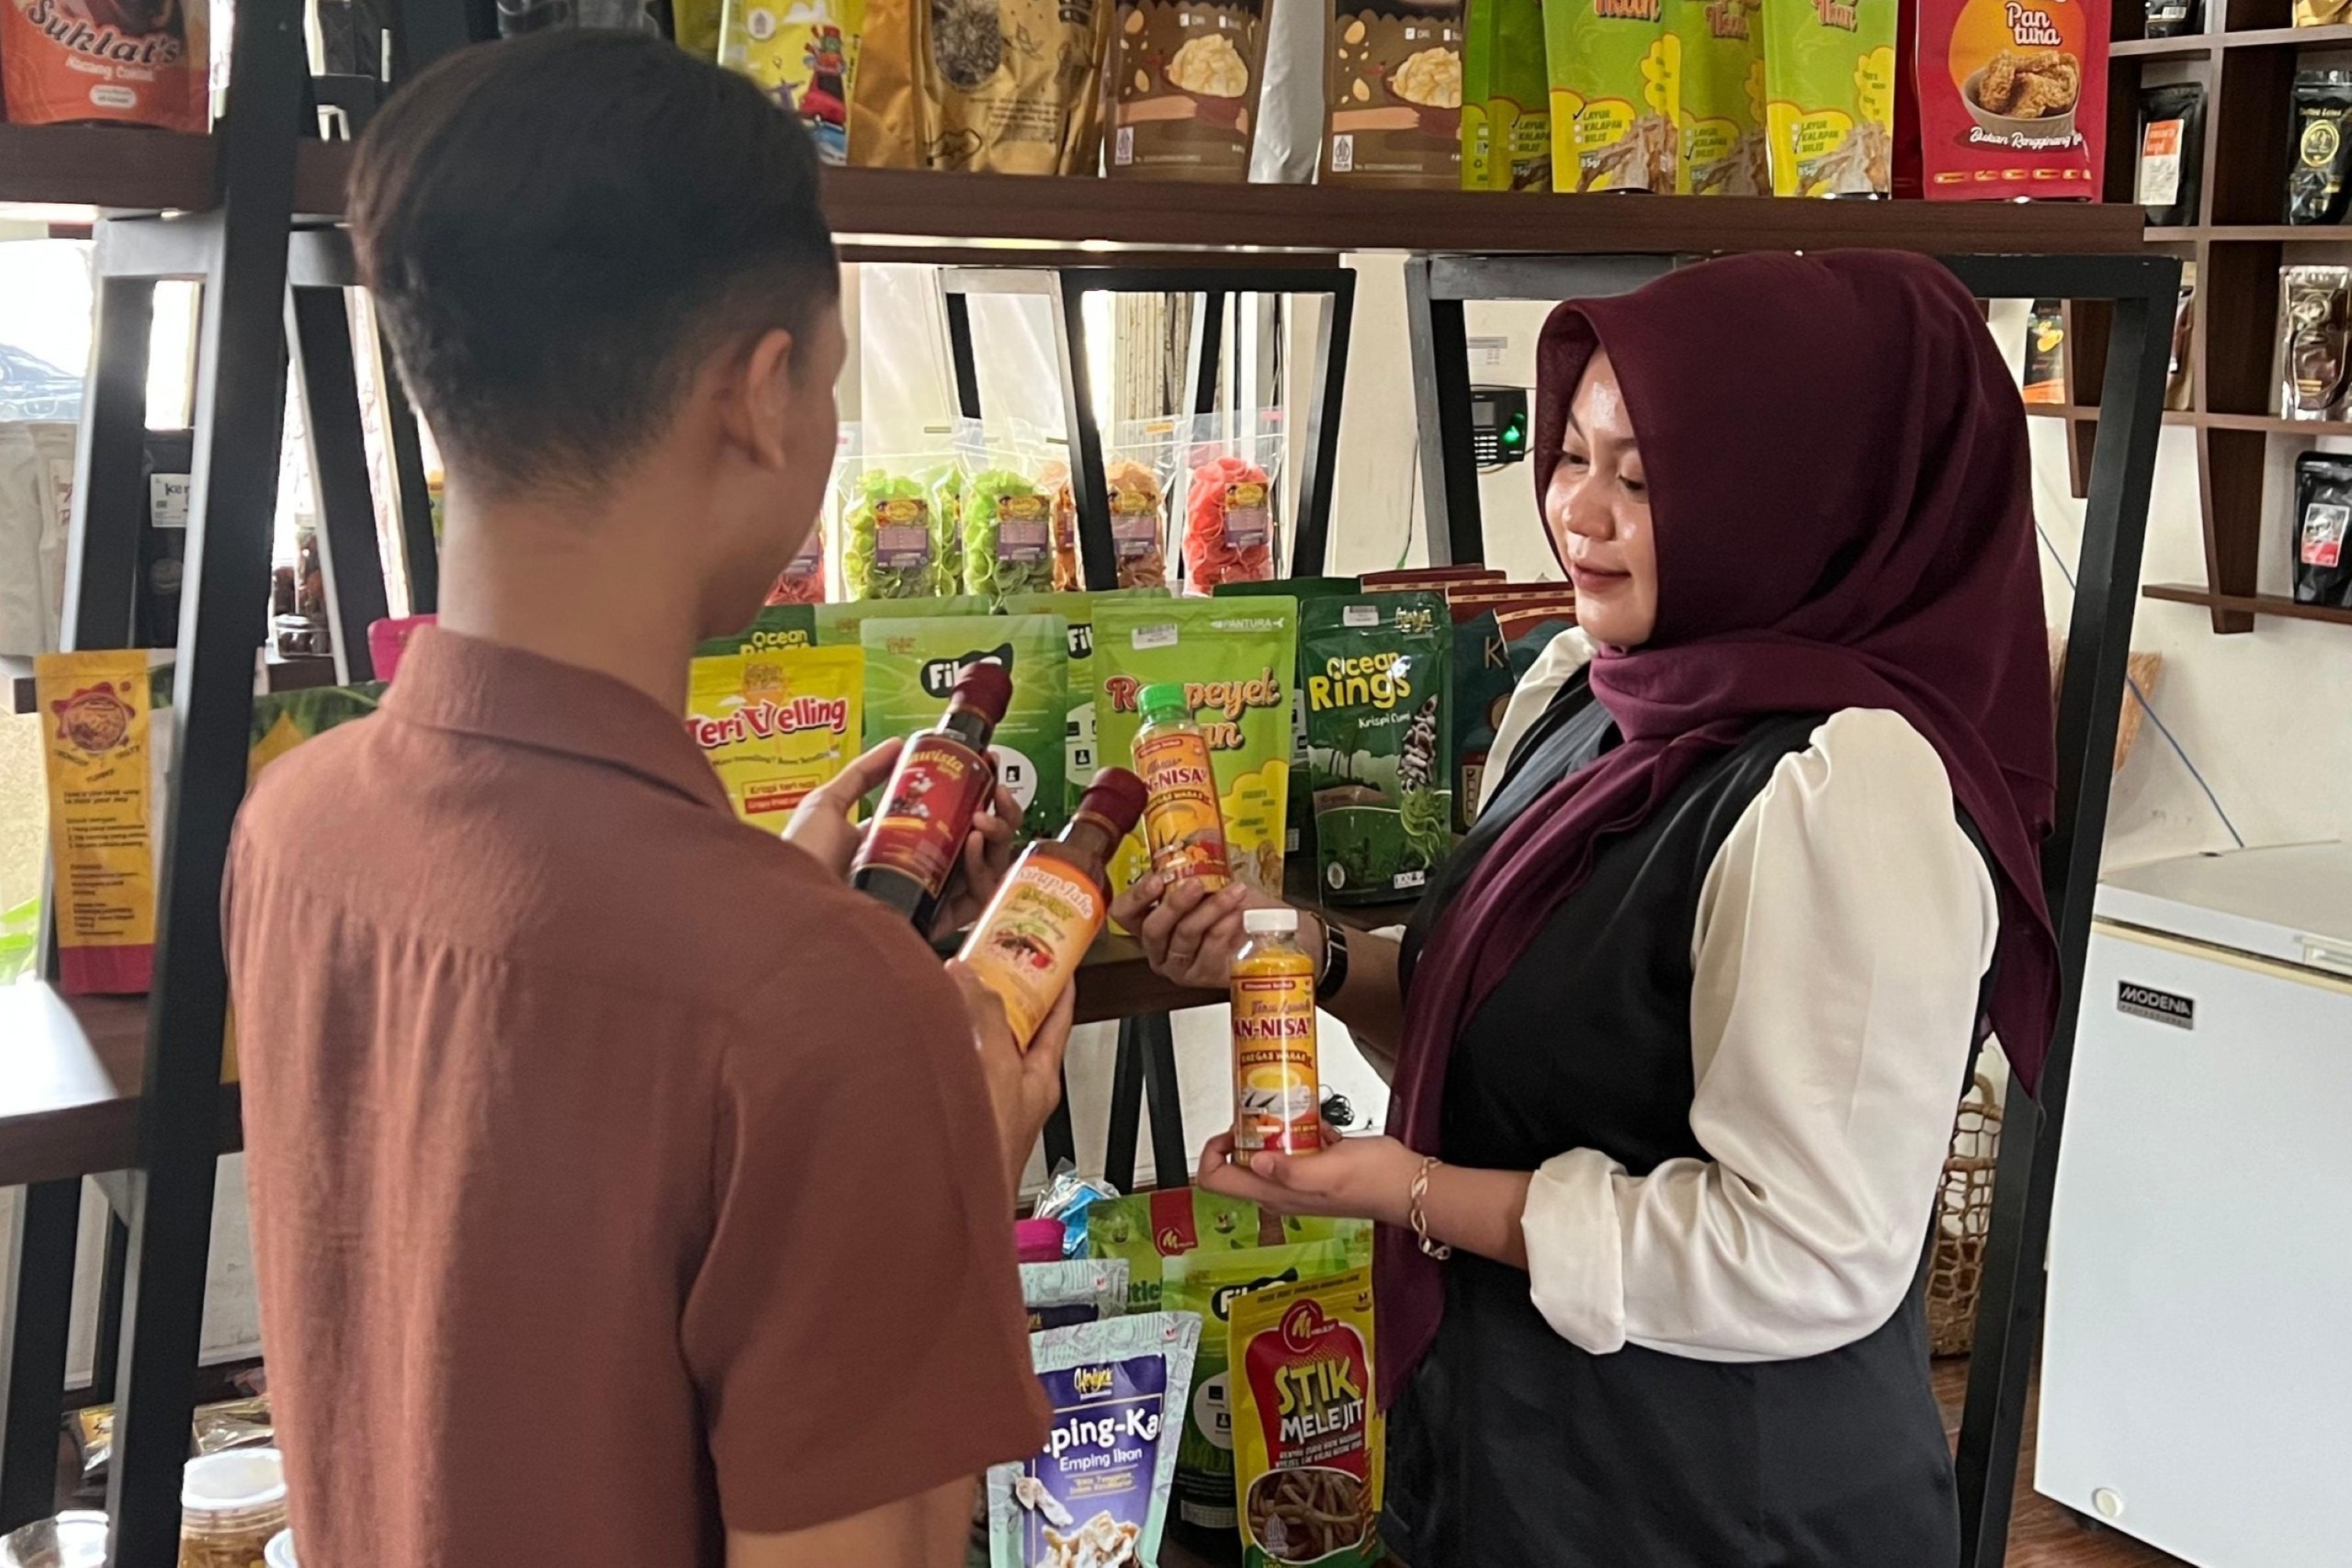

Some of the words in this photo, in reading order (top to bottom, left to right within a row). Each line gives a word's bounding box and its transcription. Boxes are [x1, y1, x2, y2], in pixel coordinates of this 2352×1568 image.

[2005, 2, 2051, 28] Pan
[1222, 618, 1272, 628] PANTURA
[752, 630, 809, 648] Ocean
[1327, 652, 1399, 681] Ocean
[1308, 672, 1411, 711] Rings
[742, 696, 847, 739] Velling
[1359, 714, 1390, 728] Krispi
[908, 750, 965, 773] awista
[2120, 985, 2191, 1015] MODENA
[1274, 1356, 1361, 1414] STIK
[1043, 1408, 1163, 1459] ping-Ka
[1279, 1399, 1364, 1444] MELEJIT
[1059, 1453, 1110, 1472] Emping
[1113, 1448, 1142, 1463] Ikan
